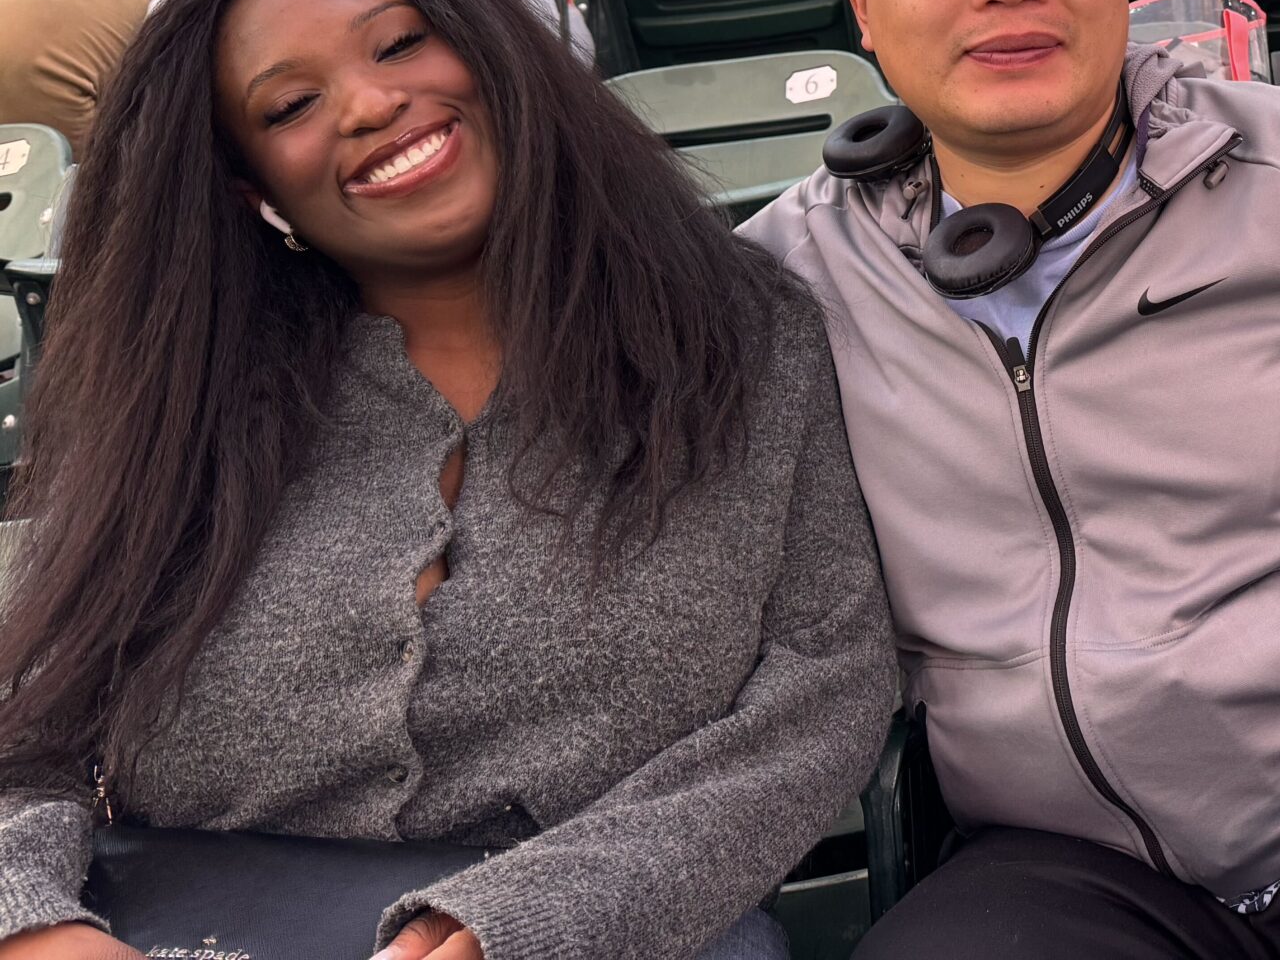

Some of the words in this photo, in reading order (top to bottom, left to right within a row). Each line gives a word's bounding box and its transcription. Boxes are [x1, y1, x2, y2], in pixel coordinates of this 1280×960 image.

[804, 74, 818, 95] 6
[1056, 192, 1094, 228] PHILIPS
[145, 945, 187, 958] kate
[190, 948, 250, 960] spade
